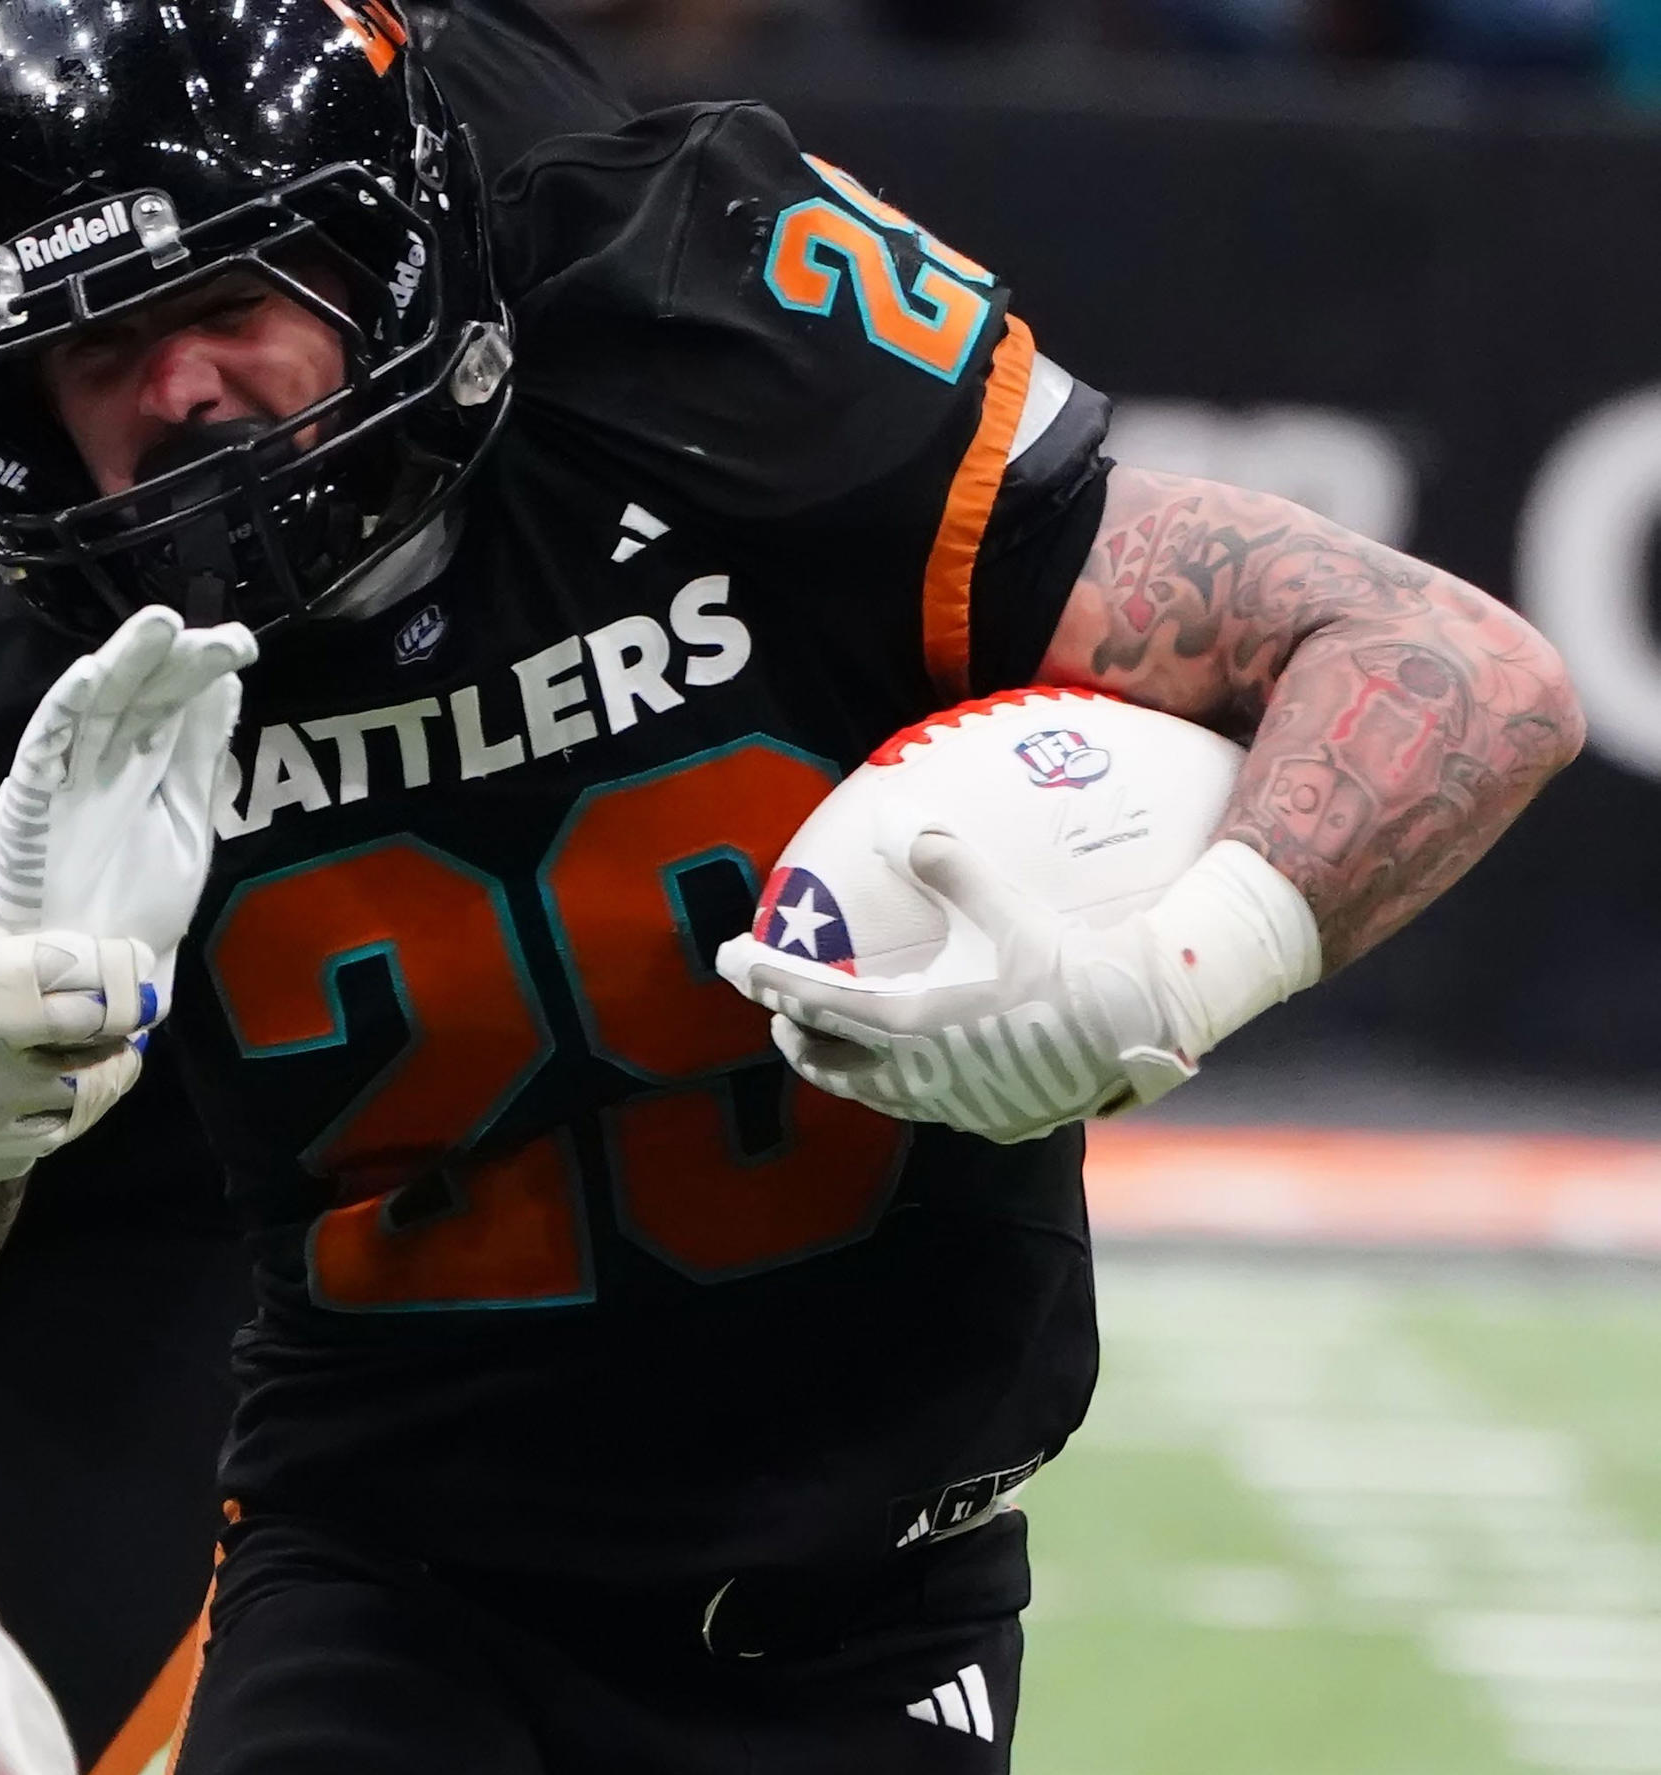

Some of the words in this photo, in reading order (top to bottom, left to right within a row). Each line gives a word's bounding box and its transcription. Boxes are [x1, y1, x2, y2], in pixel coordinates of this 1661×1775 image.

[15, 200, 130, 273] Riddell
[763, 151, 998, 385] 2
[205, 732, 914, 1314] 29
